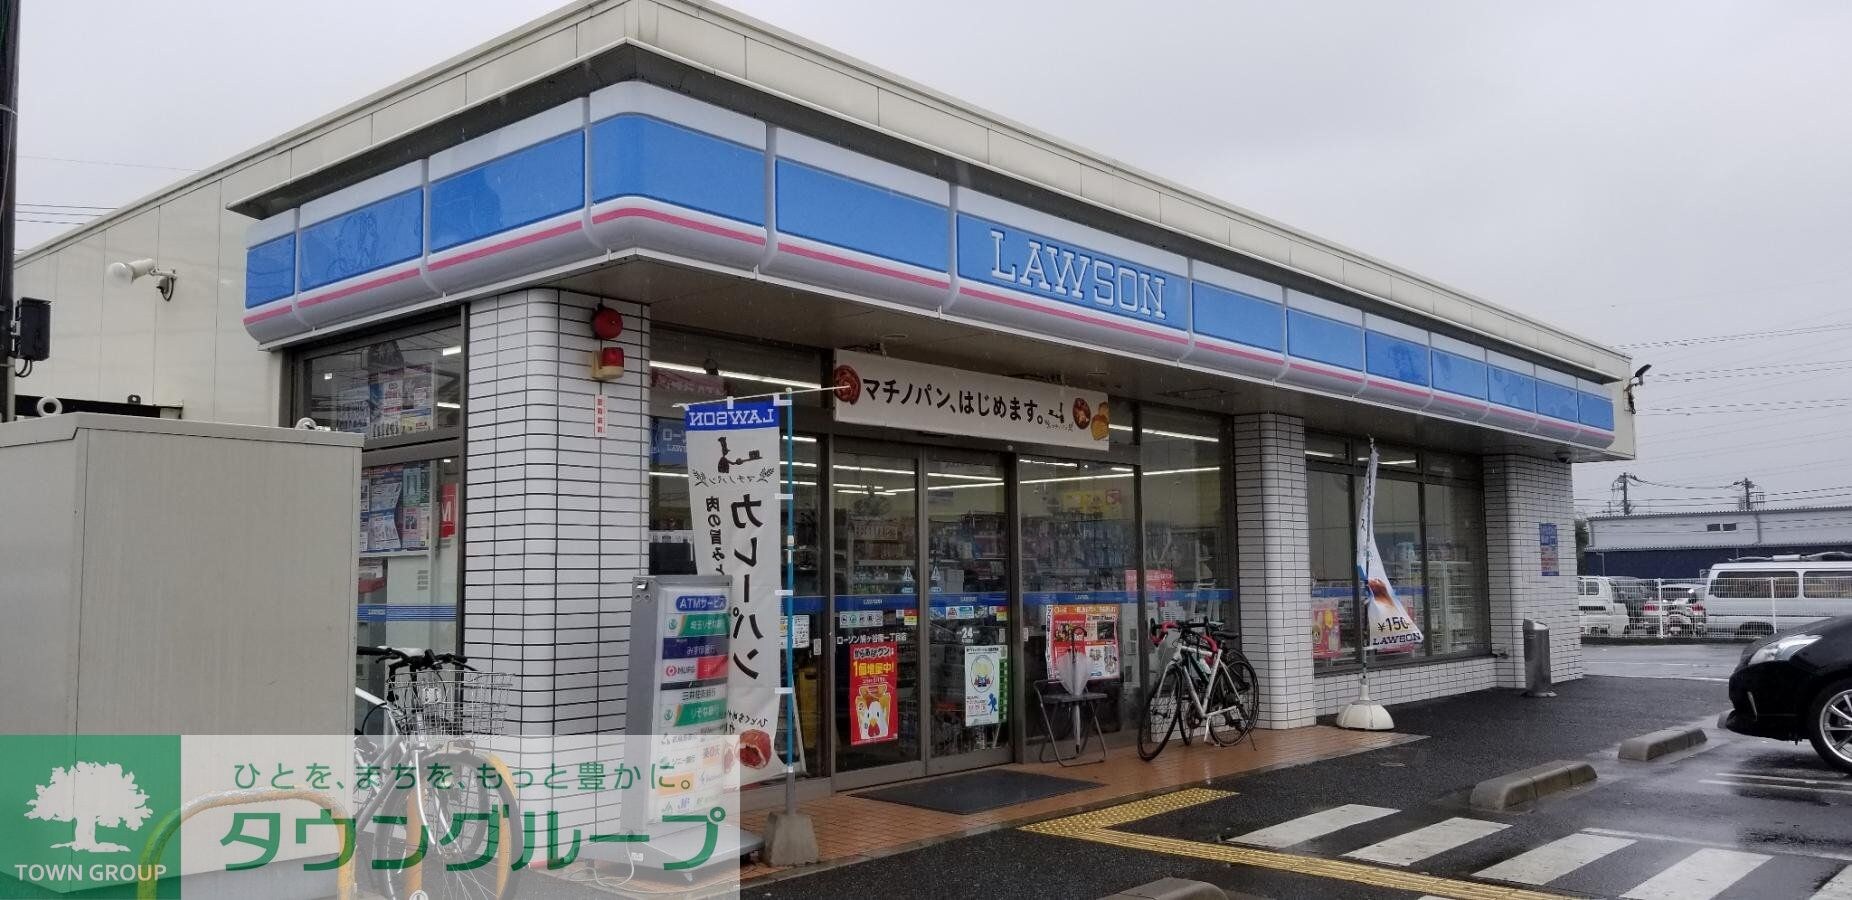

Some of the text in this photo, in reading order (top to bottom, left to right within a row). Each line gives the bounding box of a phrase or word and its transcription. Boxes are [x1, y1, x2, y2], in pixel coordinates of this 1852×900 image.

[990, 230, 1167, 320] LAWSON
[862, 377, 1044, 426] マチノパン、はじめます。
[680, 595, 726, 609] ATMサービス
[1372, 632, 1421, 646] LAWSON
[852, 660, 895, 677] 1個増量中!
